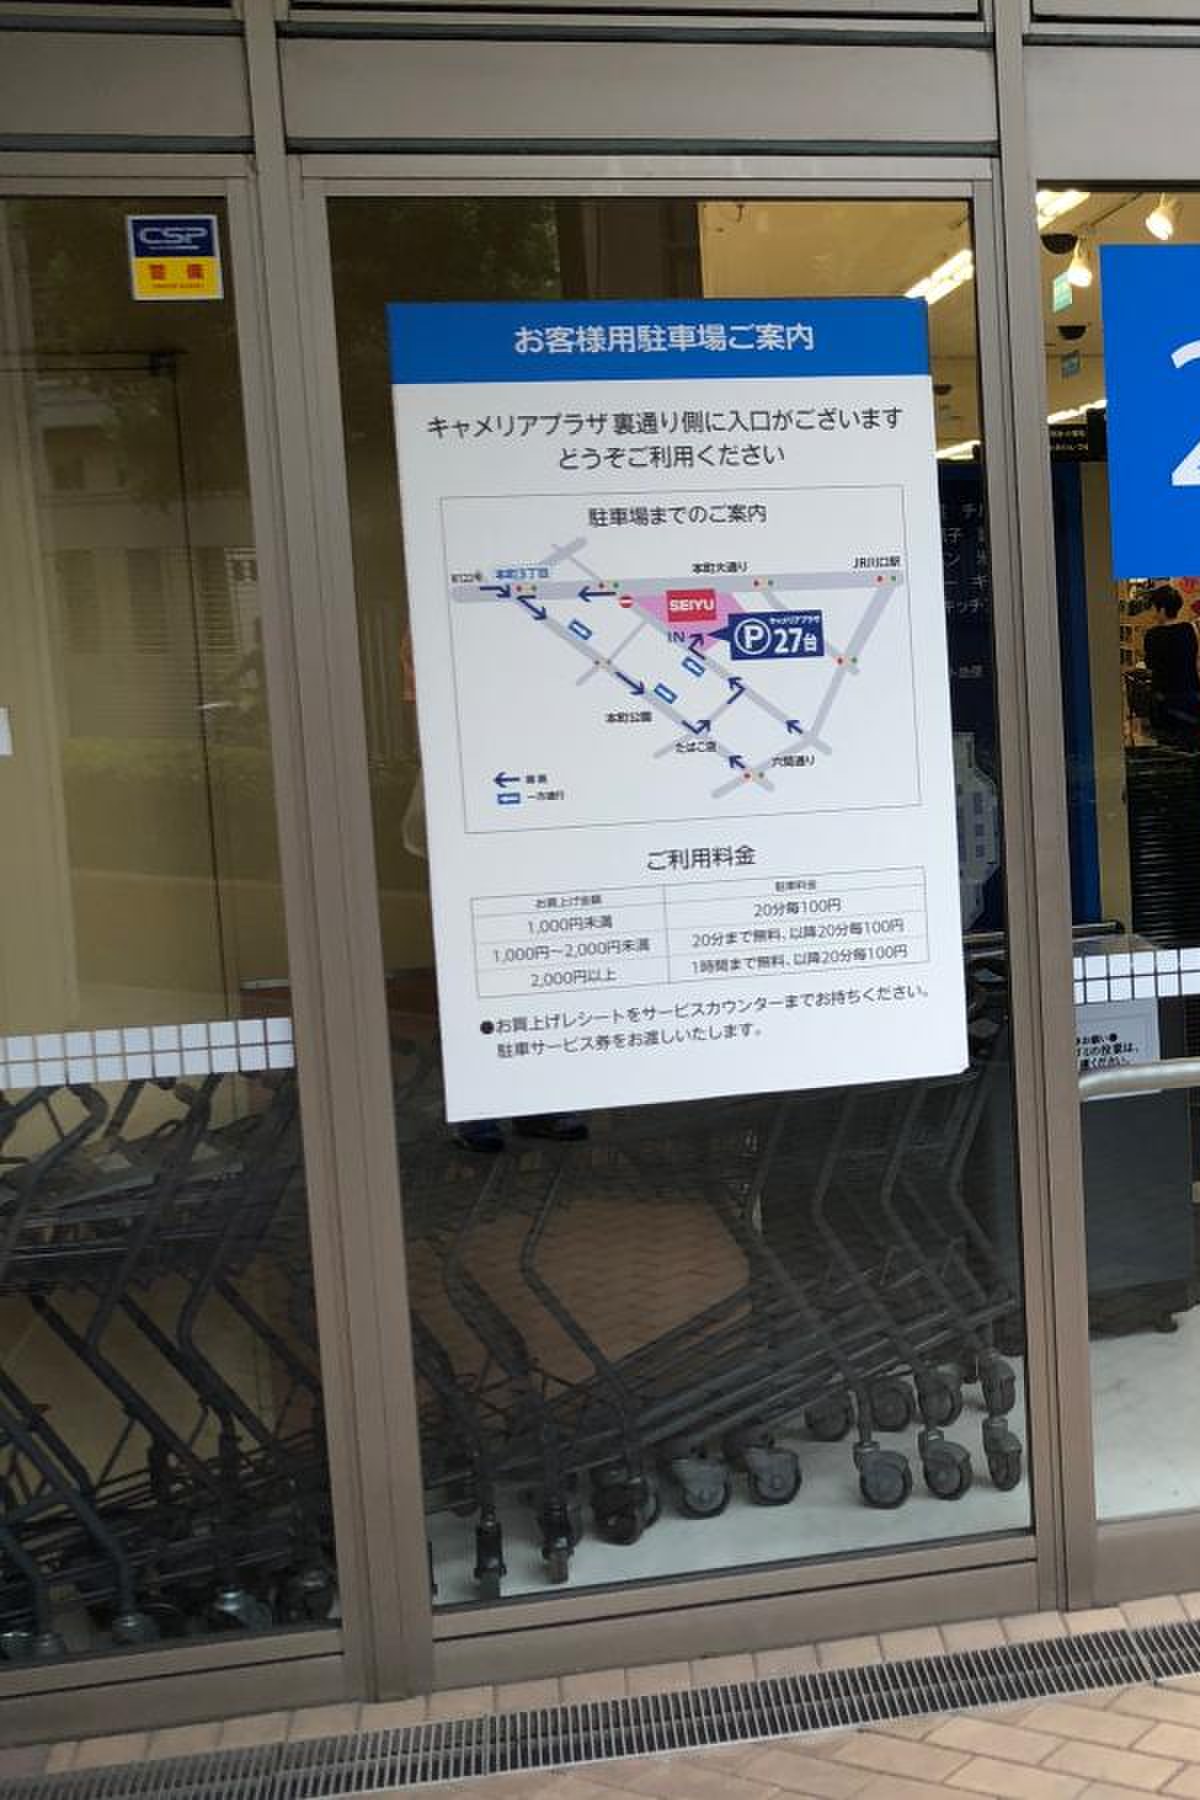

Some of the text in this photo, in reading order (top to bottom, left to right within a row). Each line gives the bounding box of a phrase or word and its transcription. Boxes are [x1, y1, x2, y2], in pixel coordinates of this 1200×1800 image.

[514, 323, 815, 355] お客様用駐車場ご案内
[559, 444, 785, 471] どうぞご利用ください
[588, 504, 767, 528] 駐車場までのご案内
[668, 598, 715, 612] SEIYU
[667, 631, 685, 643] IN
[646, 845, 757, 871] ご利用料金
[528, 914, 613, 936] 1,000円未満
[530, 967, 617, 988] 2,000円以上
